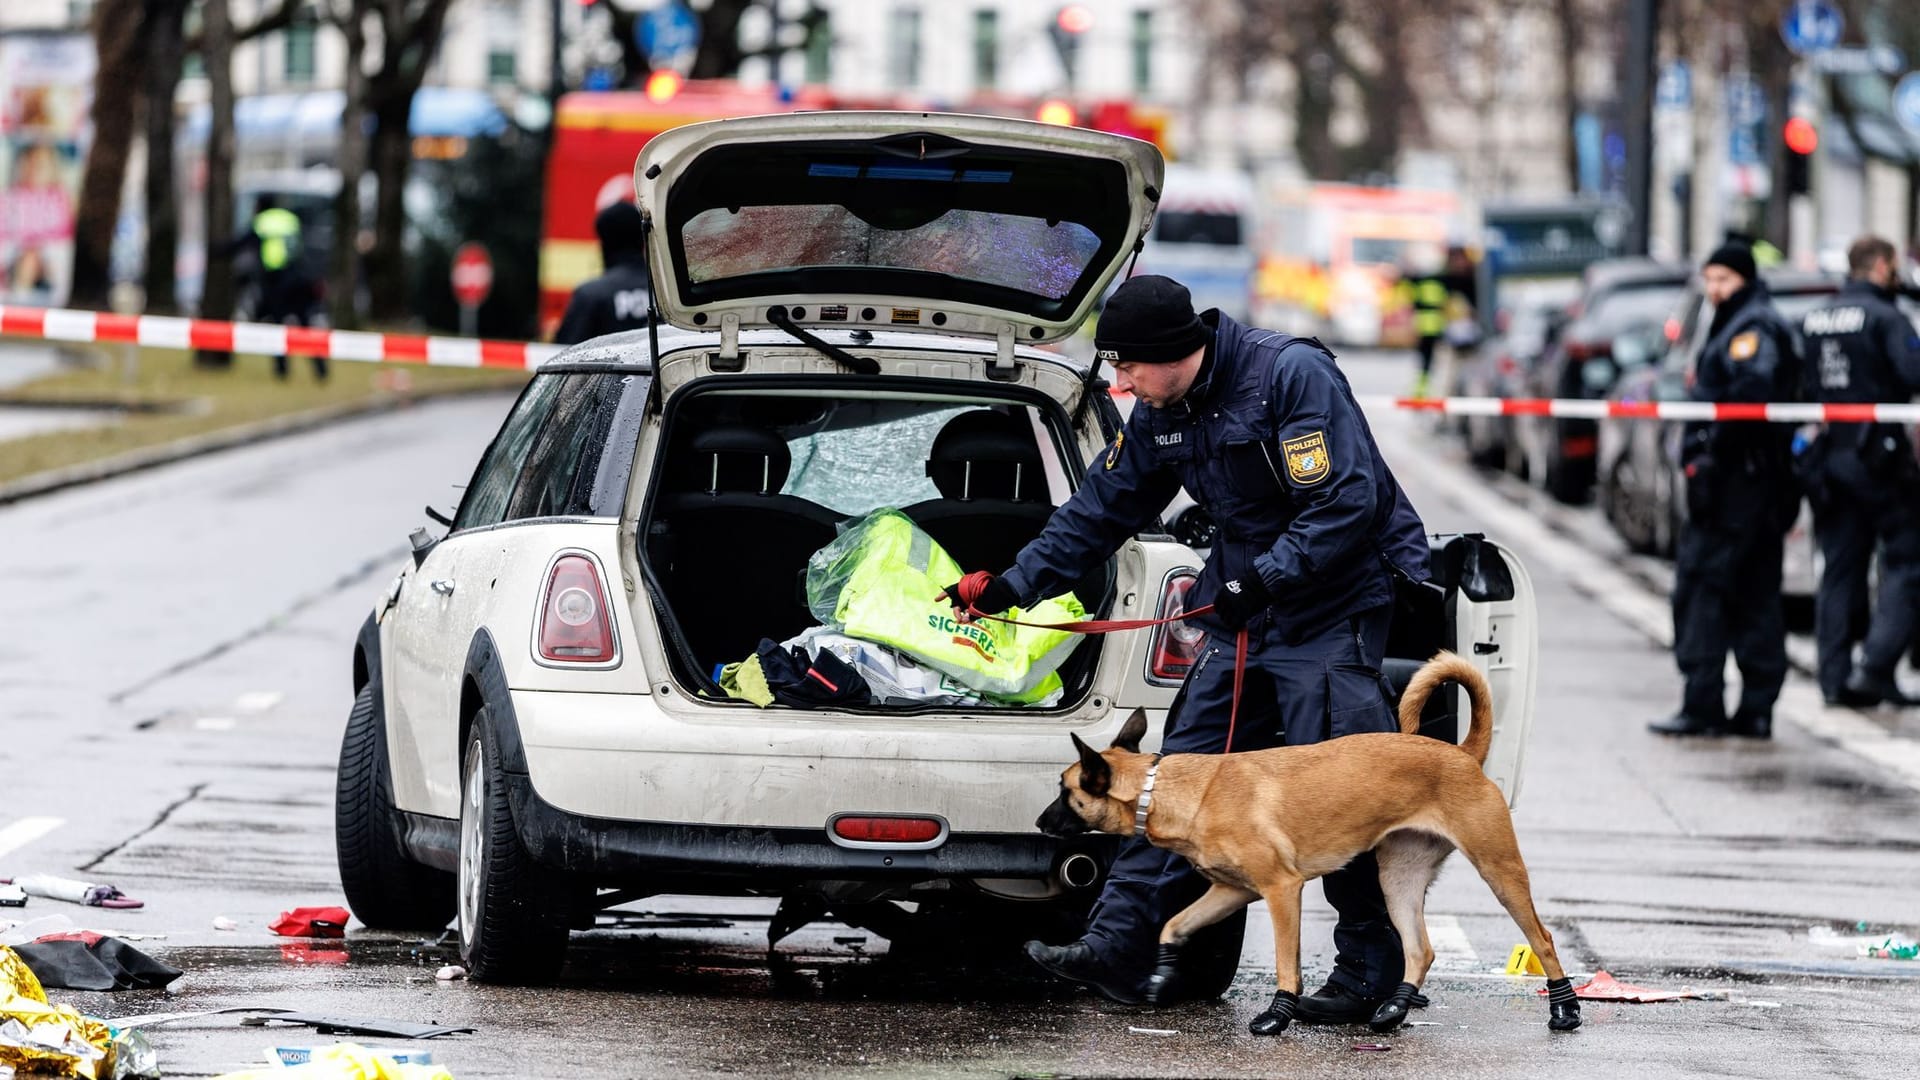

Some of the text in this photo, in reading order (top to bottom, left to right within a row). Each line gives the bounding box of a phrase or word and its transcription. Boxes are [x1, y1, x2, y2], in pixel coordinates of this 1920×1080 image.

[614, 288, 650, 320] PO
[1154, 431, 1182, 447] POLIZEI
[1287, 437, 1321, 452] POLIZEI
[1515, 949, 1526, 970] 1
